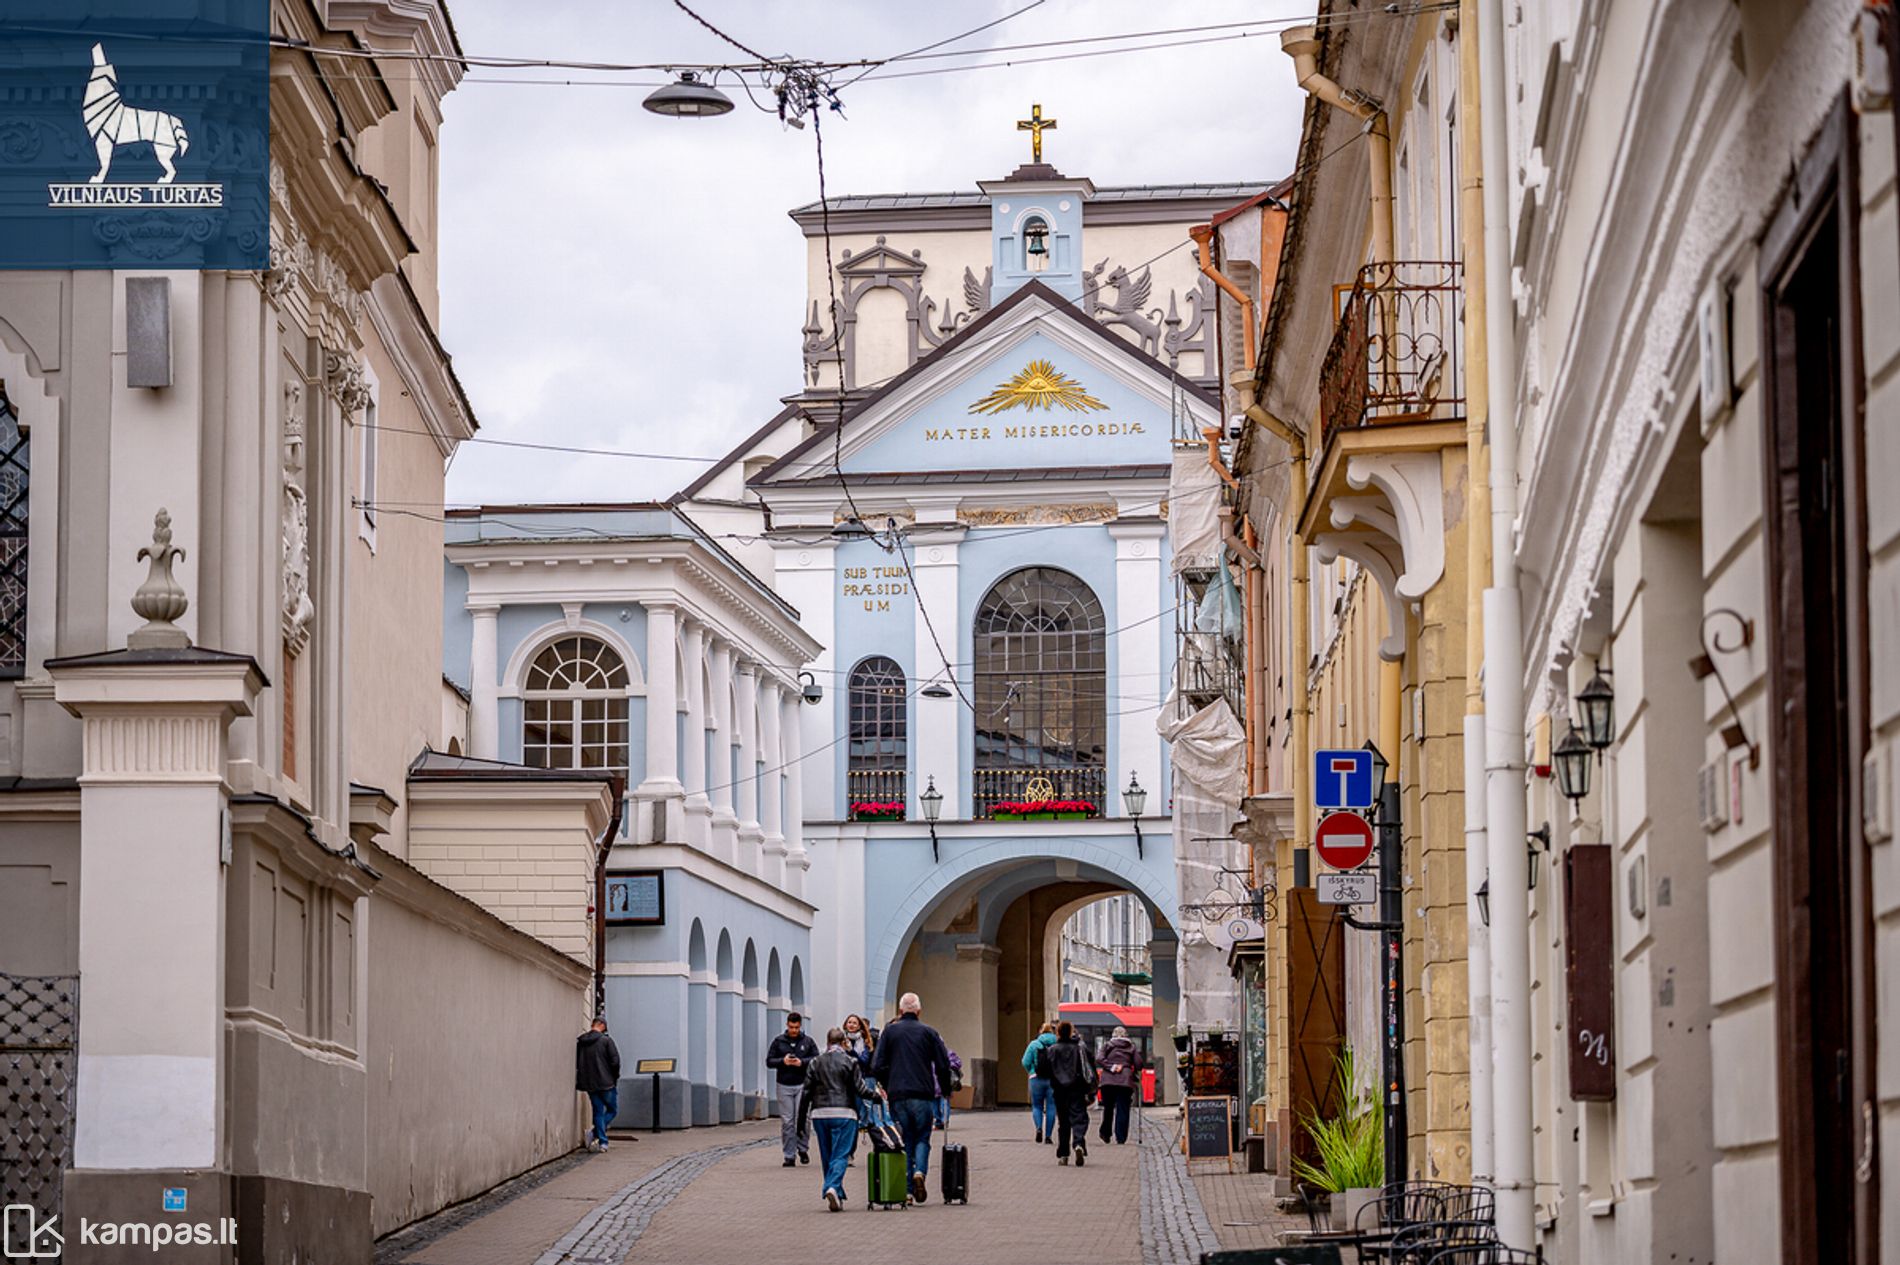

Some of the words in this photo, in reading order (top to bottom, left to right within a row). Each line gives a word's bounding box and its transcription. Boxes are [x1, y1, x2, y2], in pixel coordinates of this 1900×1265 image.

[926, 427, 991, 441] MATER
[844, 567, 867, 579] SUB
[872, 566, 909, 579] TUUM
